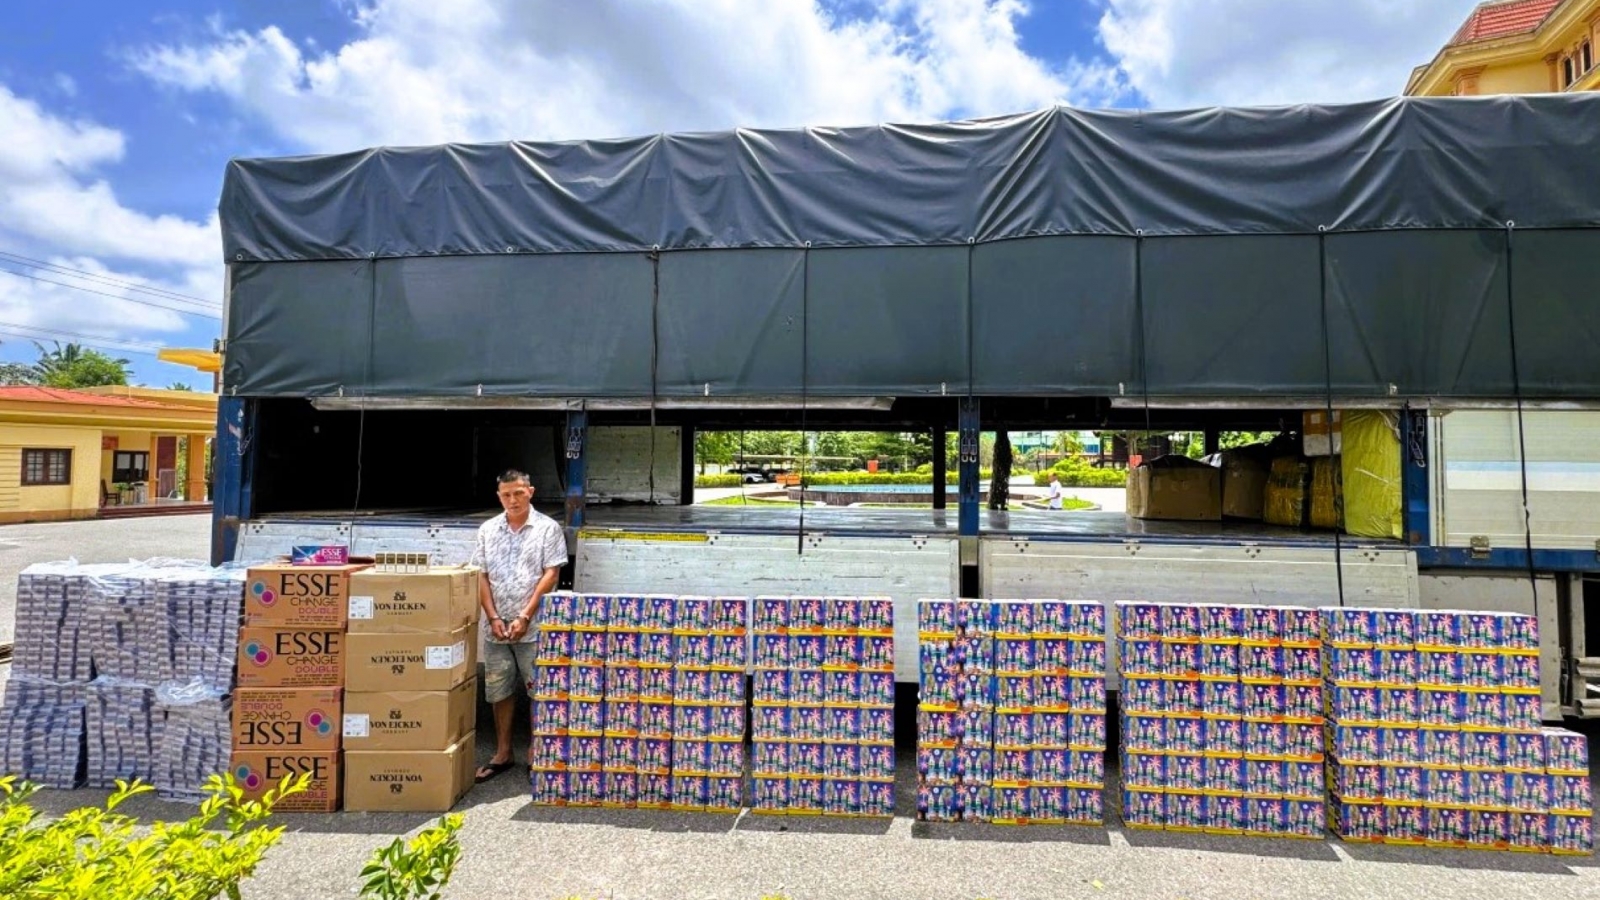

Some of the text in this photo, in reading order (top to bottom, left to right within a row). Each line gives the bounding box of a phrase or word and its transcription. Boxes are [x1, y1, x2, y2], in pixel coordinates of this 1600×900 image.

[321, 548, 342, 556] ESSE
[280, 573, 340, 597] ESSE
[290, 597, 338, 607] CHANGE
[275, 631, 340, 655] ESSE
[286, 655, 338, 666] CHANGE
[370, 655, 425, 664] VON EICKEN
[294, 665, 338, 673] DOUBLE
[241, 710, 292, 720] CHANGE
[239, 721, 302, 745] ESSE
[265, 756, 328, 780] ESSE
[370, 774, 422, 782] VON EICKEN
